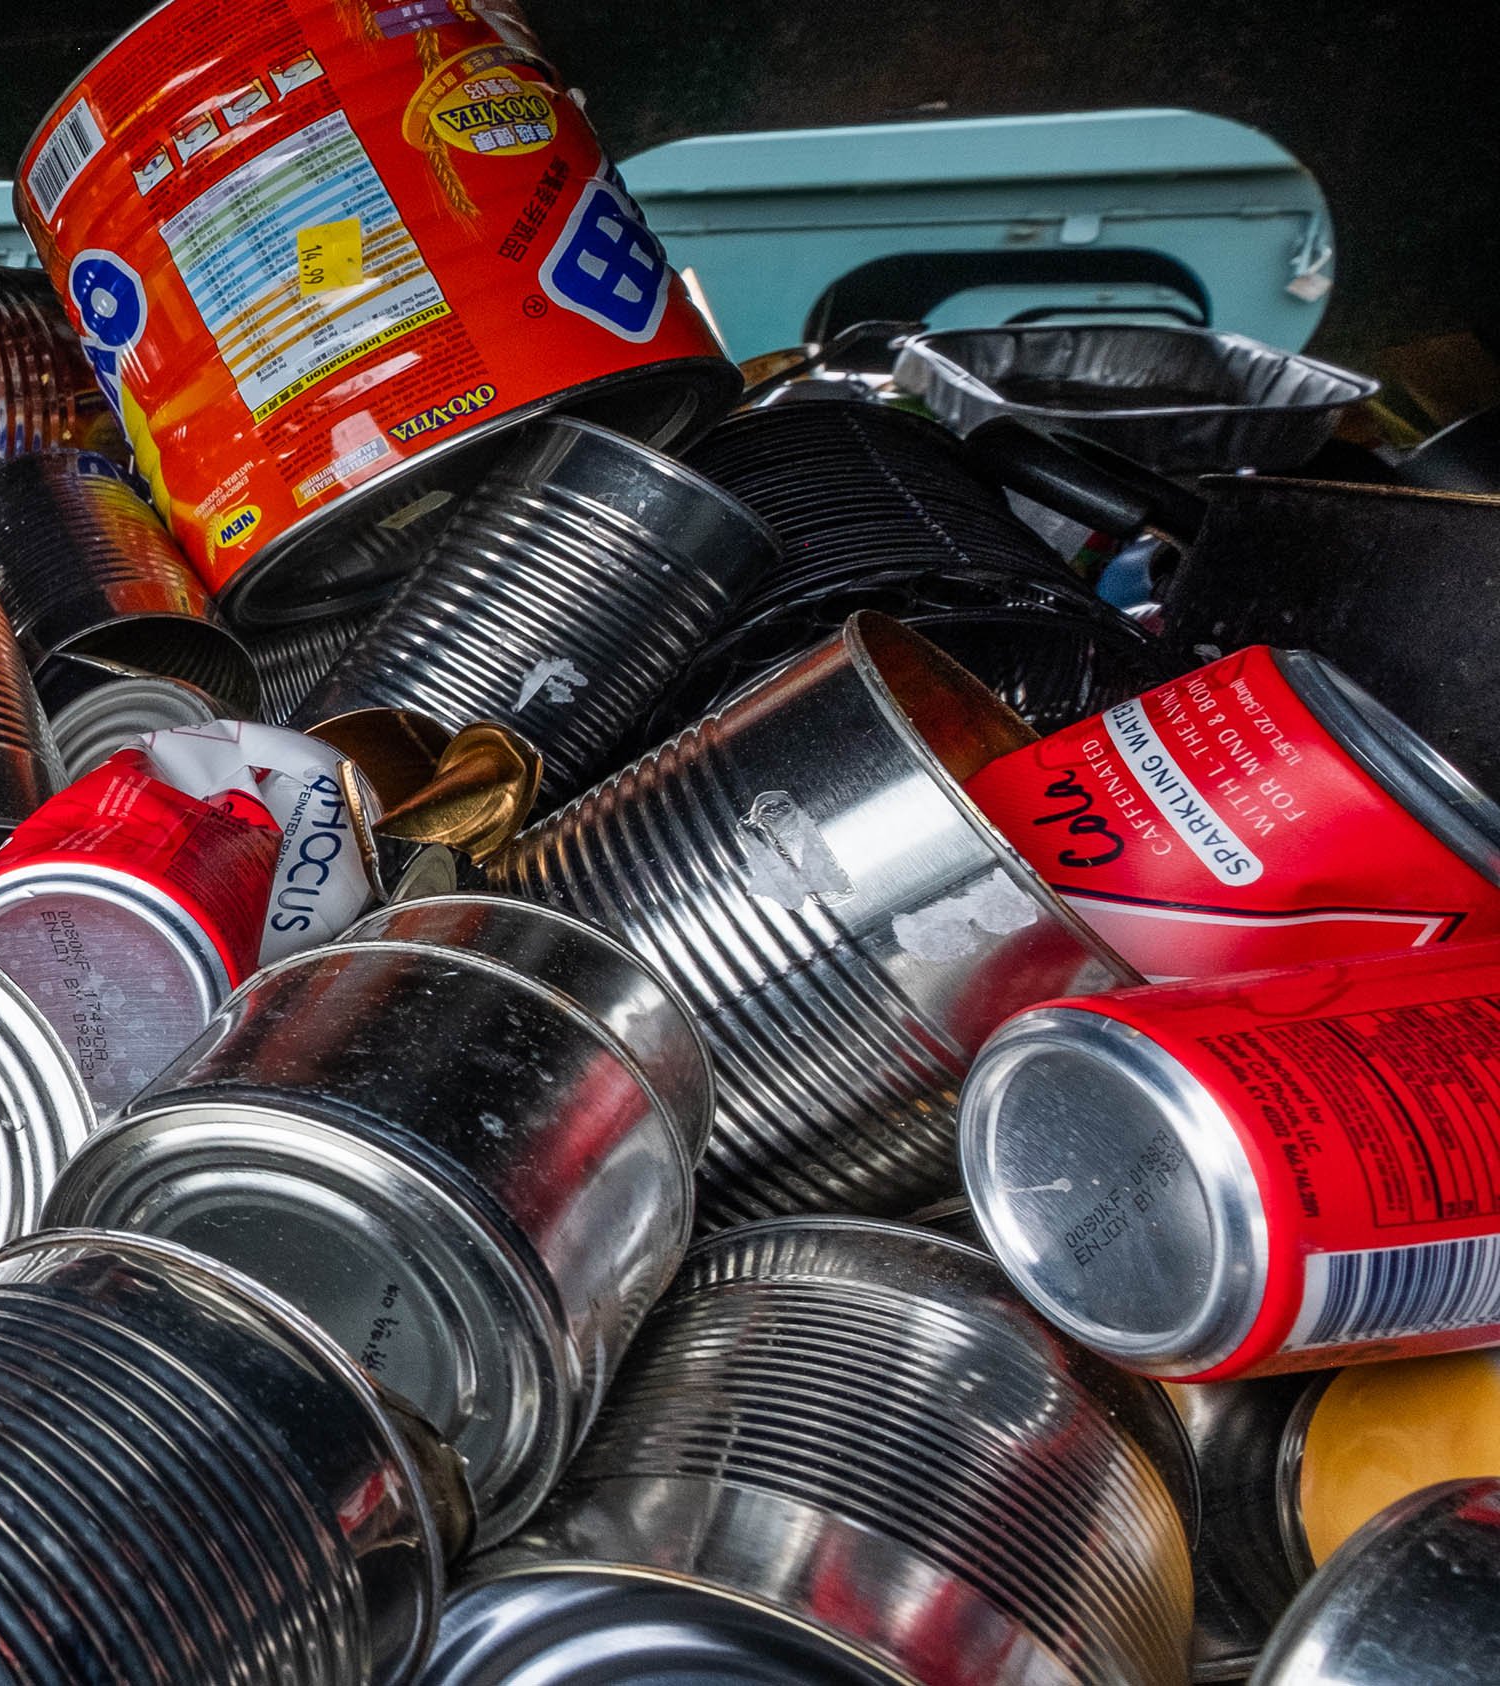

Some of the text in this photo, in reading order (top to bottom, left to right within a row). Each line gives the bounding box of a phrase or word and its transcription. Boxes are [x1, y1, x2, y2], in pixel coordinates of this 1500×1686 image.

[438, 94, 550, 132] OVO-VITA
[469, 121, 554, 154] 卓越 健康
[299, 243, 324, 287] 14.99
[383, 303, 447, 341] Nutrition
[304, 335, 383, 385] Information
[386, 381, 499, 446] OVO-VITA
[213, 474, 251, 508] ENRICHED
[221, 459, 255, 490] NATURAL
[217, 509, 257, 544] NEW
[1186, 676, 1307, 824] FOR MIND & BODY
[290, 785, 314, 840] FEINATED
[1081, 738, 1173, 856] CAFFEINATED
[1110, 698, 1251, 876] SPARKLING WATER
[1216, 777, 1276, 837] WITH
[1031, 769, 1125, 868] Cola
[40, 909, 73, 968] ENJOY
[63, 977, 83, 1002] BY
[1071, 1213, 1133, 1268] ENJOY
